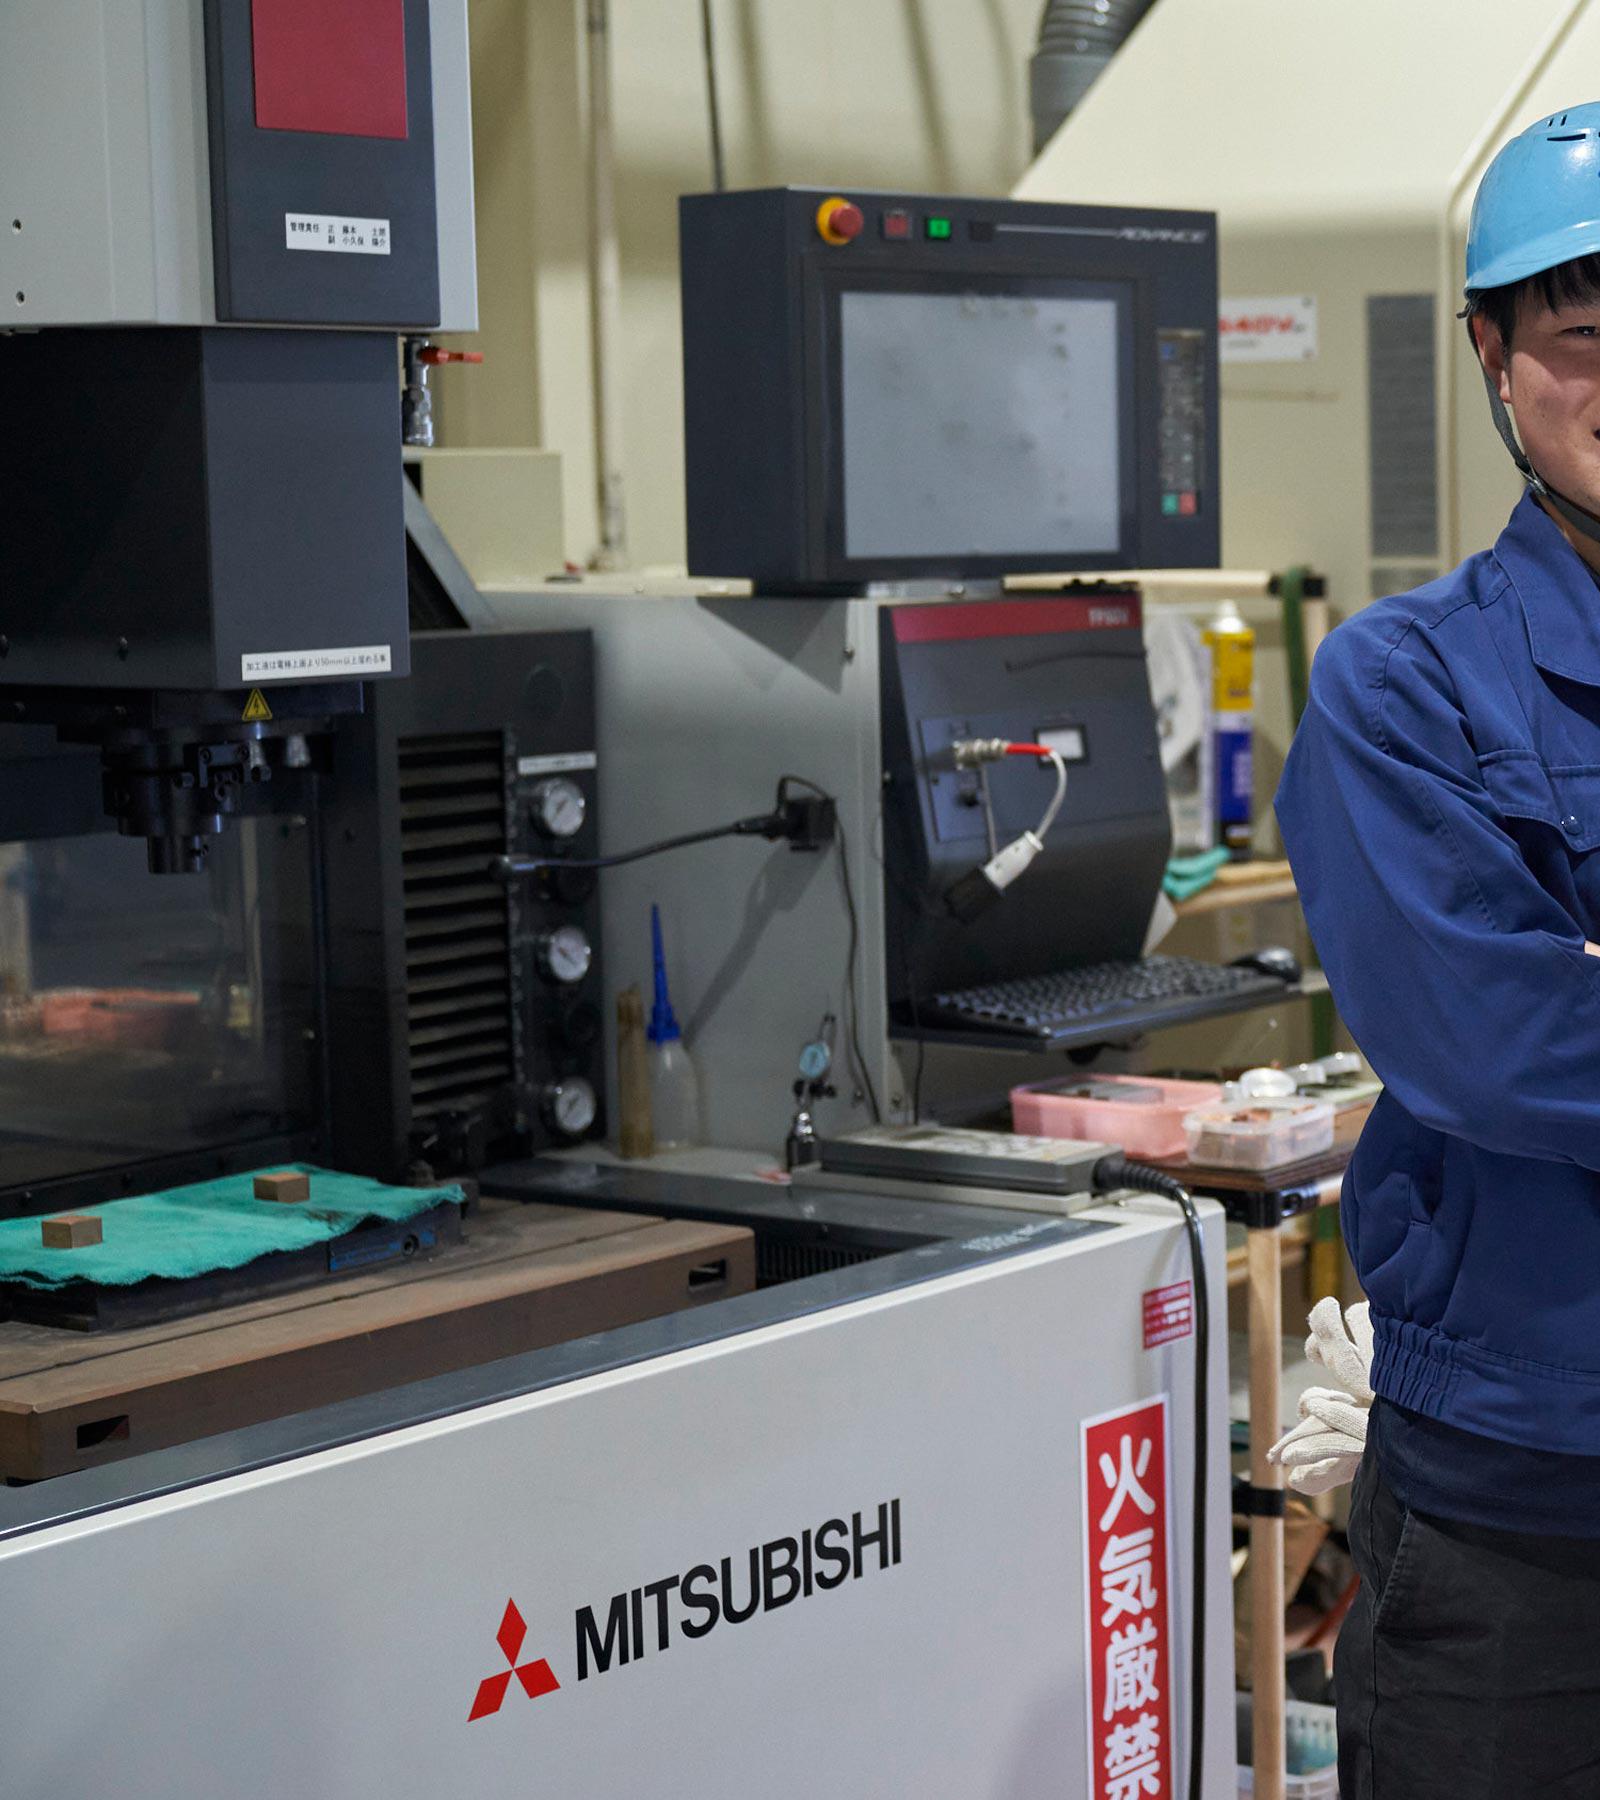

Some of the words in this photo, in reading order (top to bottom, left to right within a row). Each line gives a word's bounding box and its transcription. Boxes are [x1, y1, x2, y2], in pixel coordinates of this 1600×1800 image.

[575, 1498, 902, 1682] MITSUBISHI
[1099, 1434, 1160, 1800] 火気厳禁
